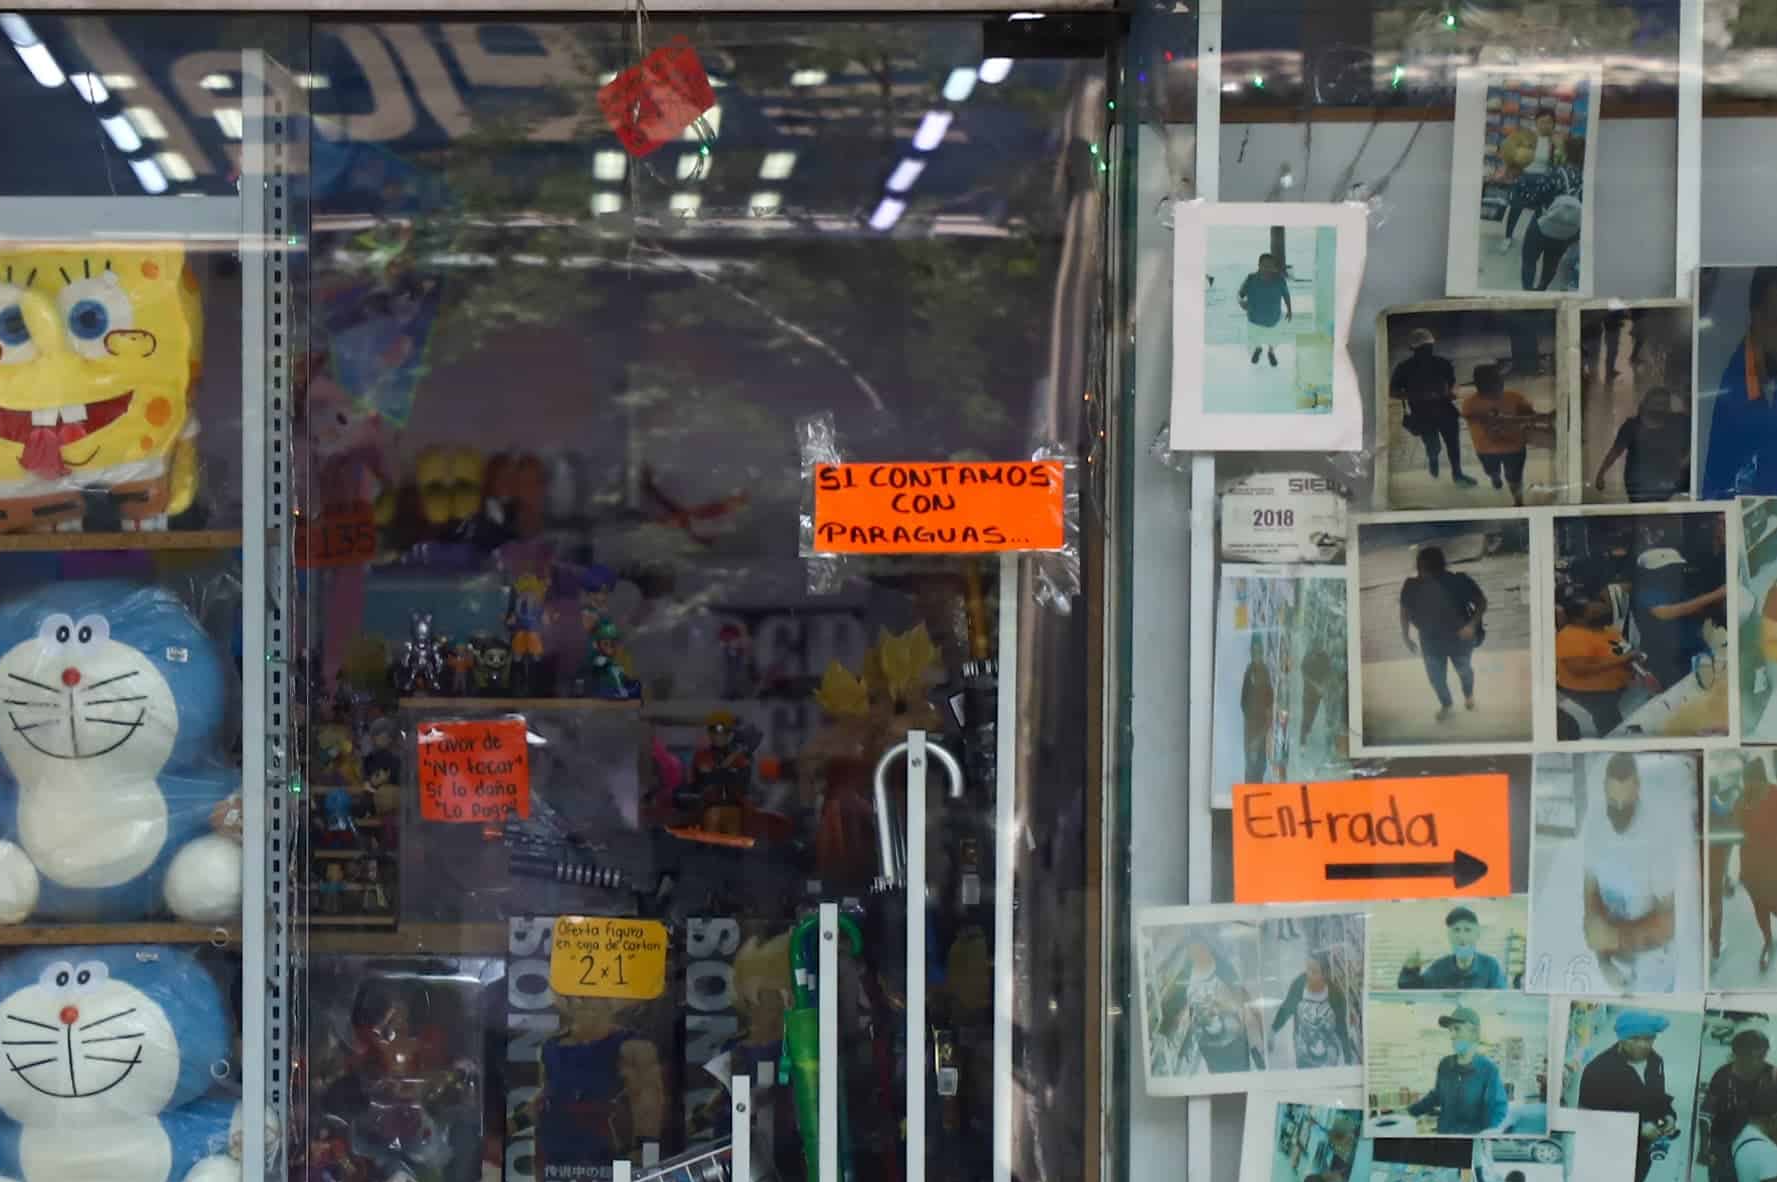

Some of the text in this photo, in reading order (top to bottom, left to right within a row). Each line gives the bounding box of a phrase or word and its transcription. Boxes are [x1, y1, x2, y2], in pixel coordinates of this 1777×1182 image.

[819, 464, 1051, 491] SI CONTAMOS
[891, 493, 956, 514] CON
[1252, 509, 1295, 527] 2018
[1243, 784, 1438, 848] Entrada
